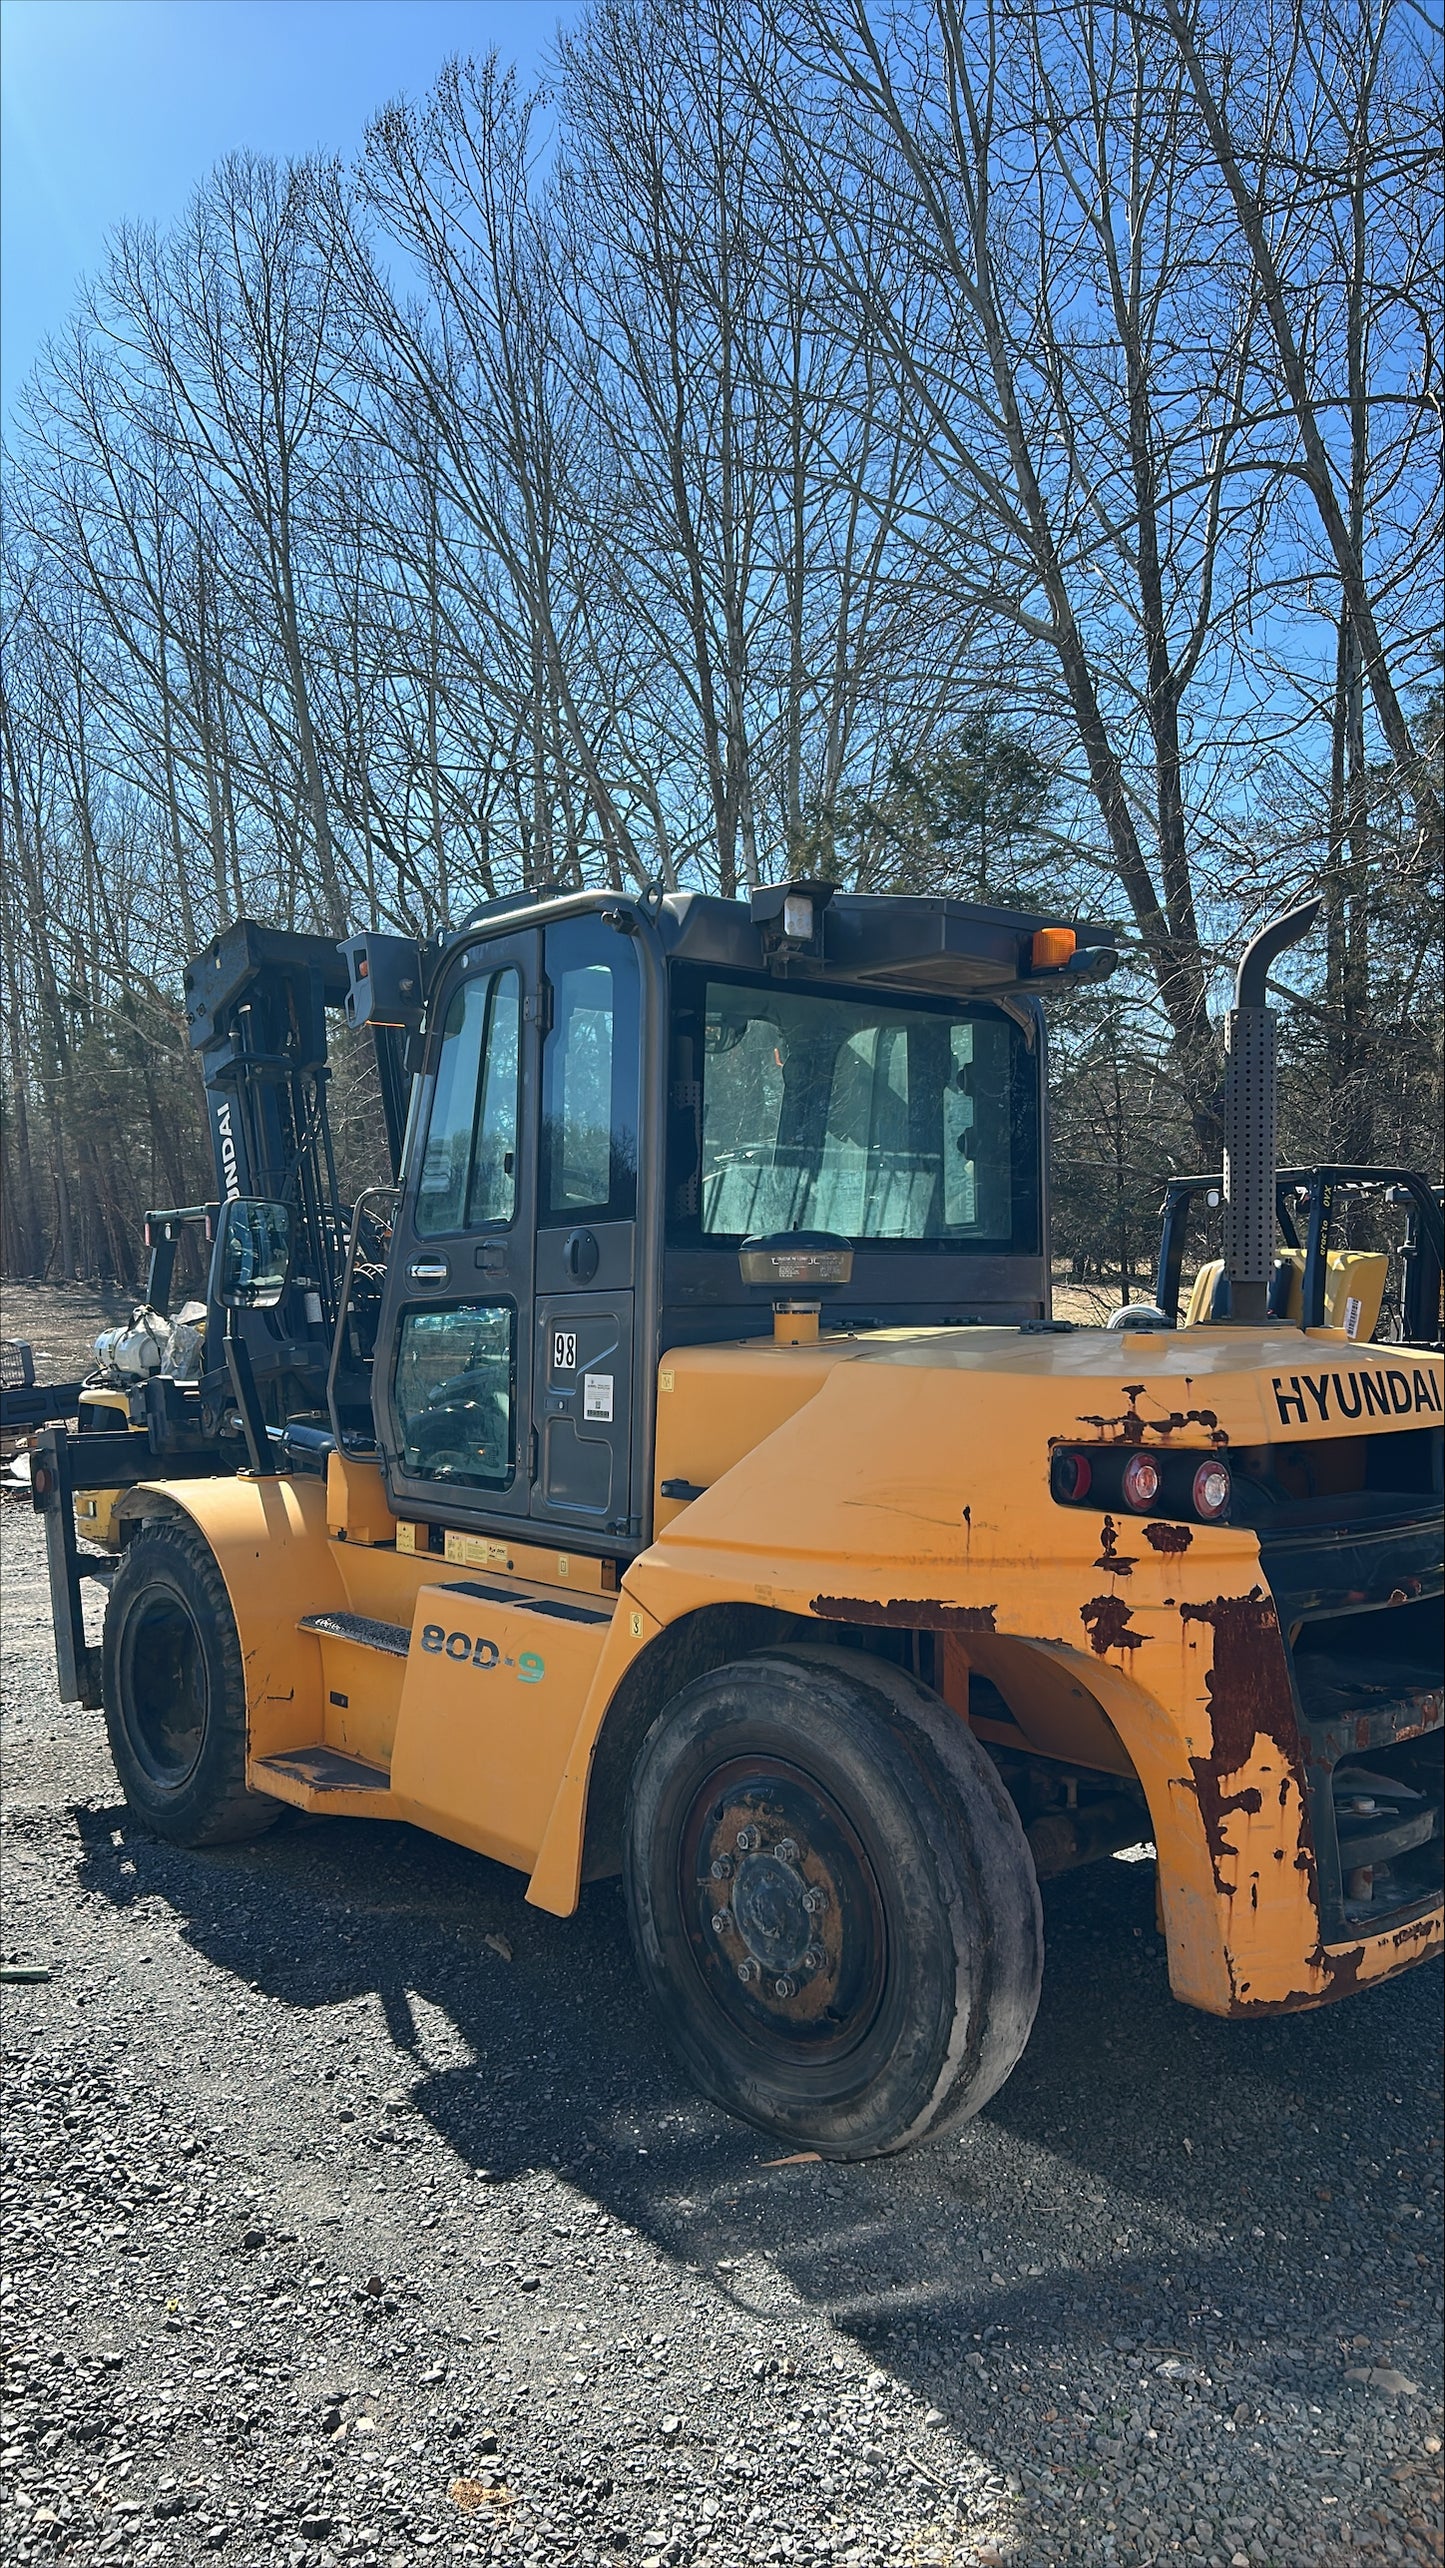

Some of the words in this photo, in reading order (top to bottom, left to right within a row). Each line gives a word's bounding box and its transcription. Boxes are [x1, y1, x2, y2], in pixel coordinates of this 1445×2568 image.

[556, 1334, 575, 1367] 98
[1272, 1369, 1442, 1425] HYUNDAI
[420, 1624, 545, 1684] 80D-9
